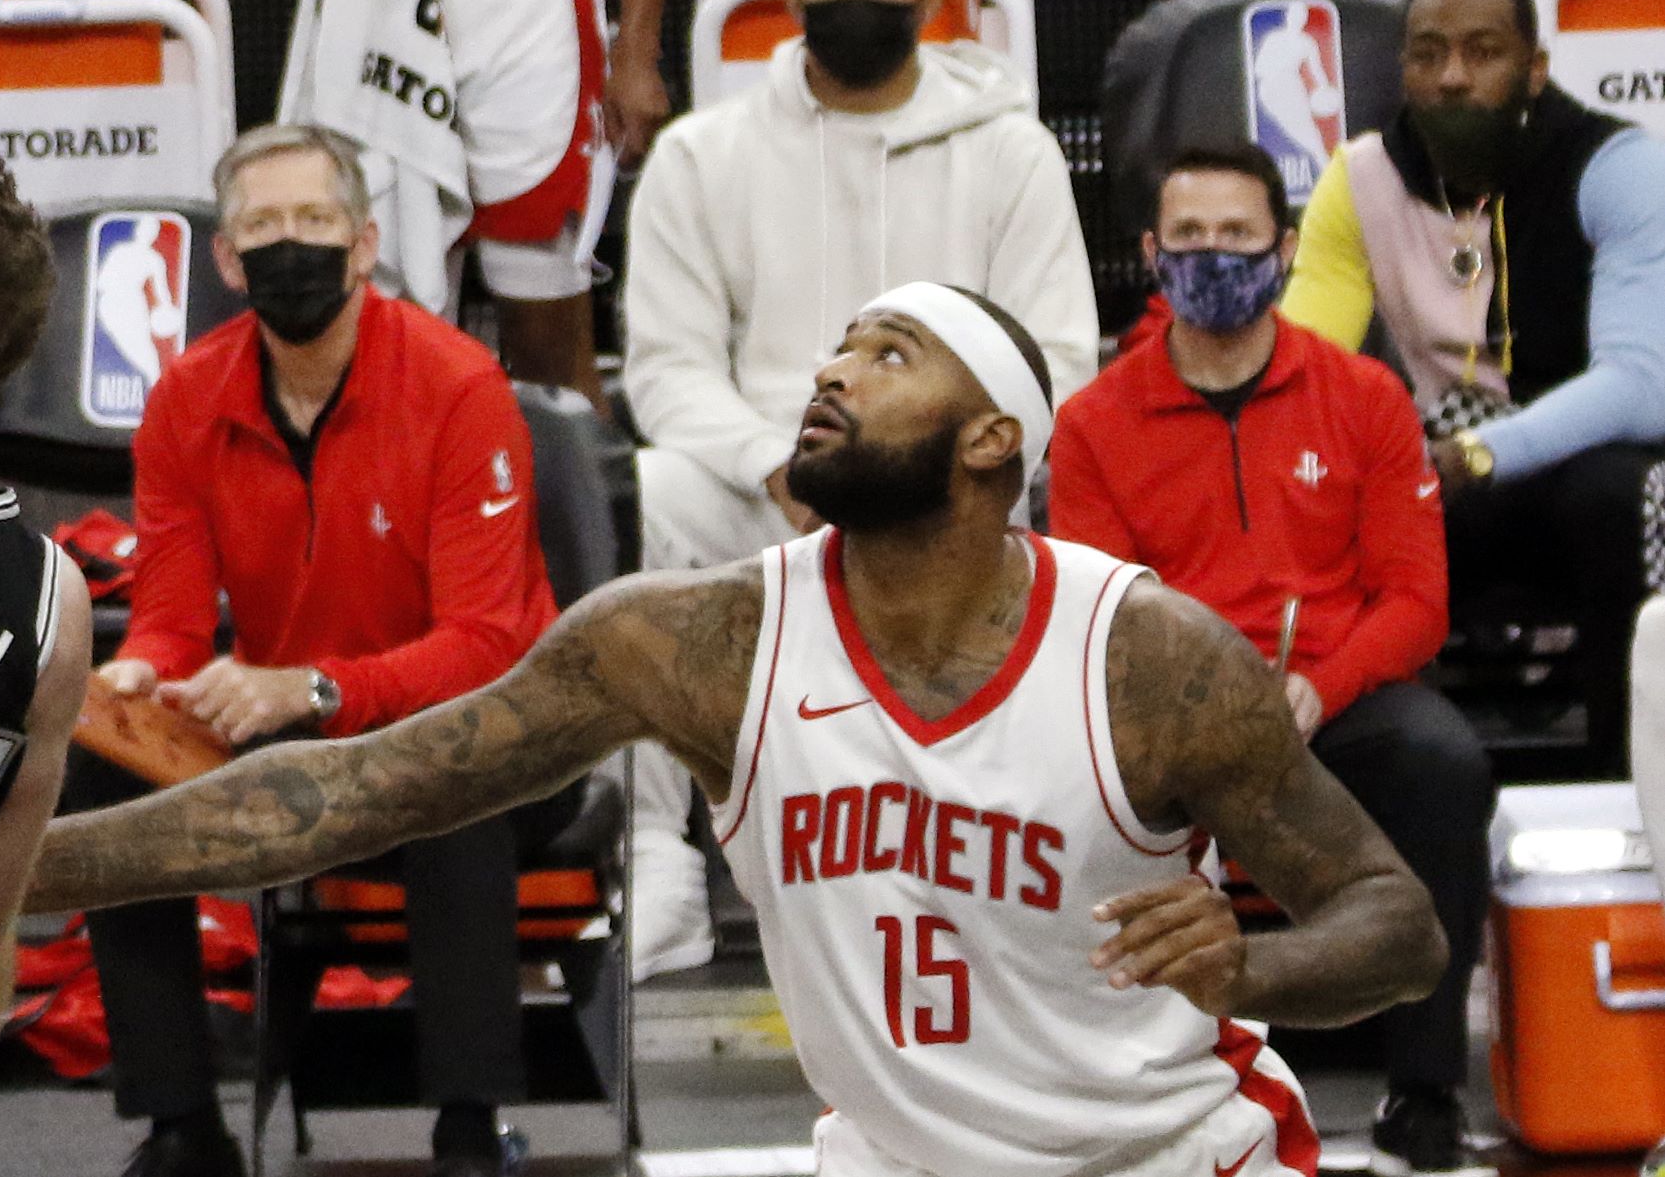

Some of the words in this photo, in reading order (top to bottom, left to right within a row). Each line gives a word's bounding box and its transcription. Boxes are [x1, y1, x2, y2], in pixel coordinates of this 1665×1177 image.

[99, 375, 144, 410] NBA
[782, 780, 1065, 913] ROCKETS
[874, 914, 971, 1049] 15
